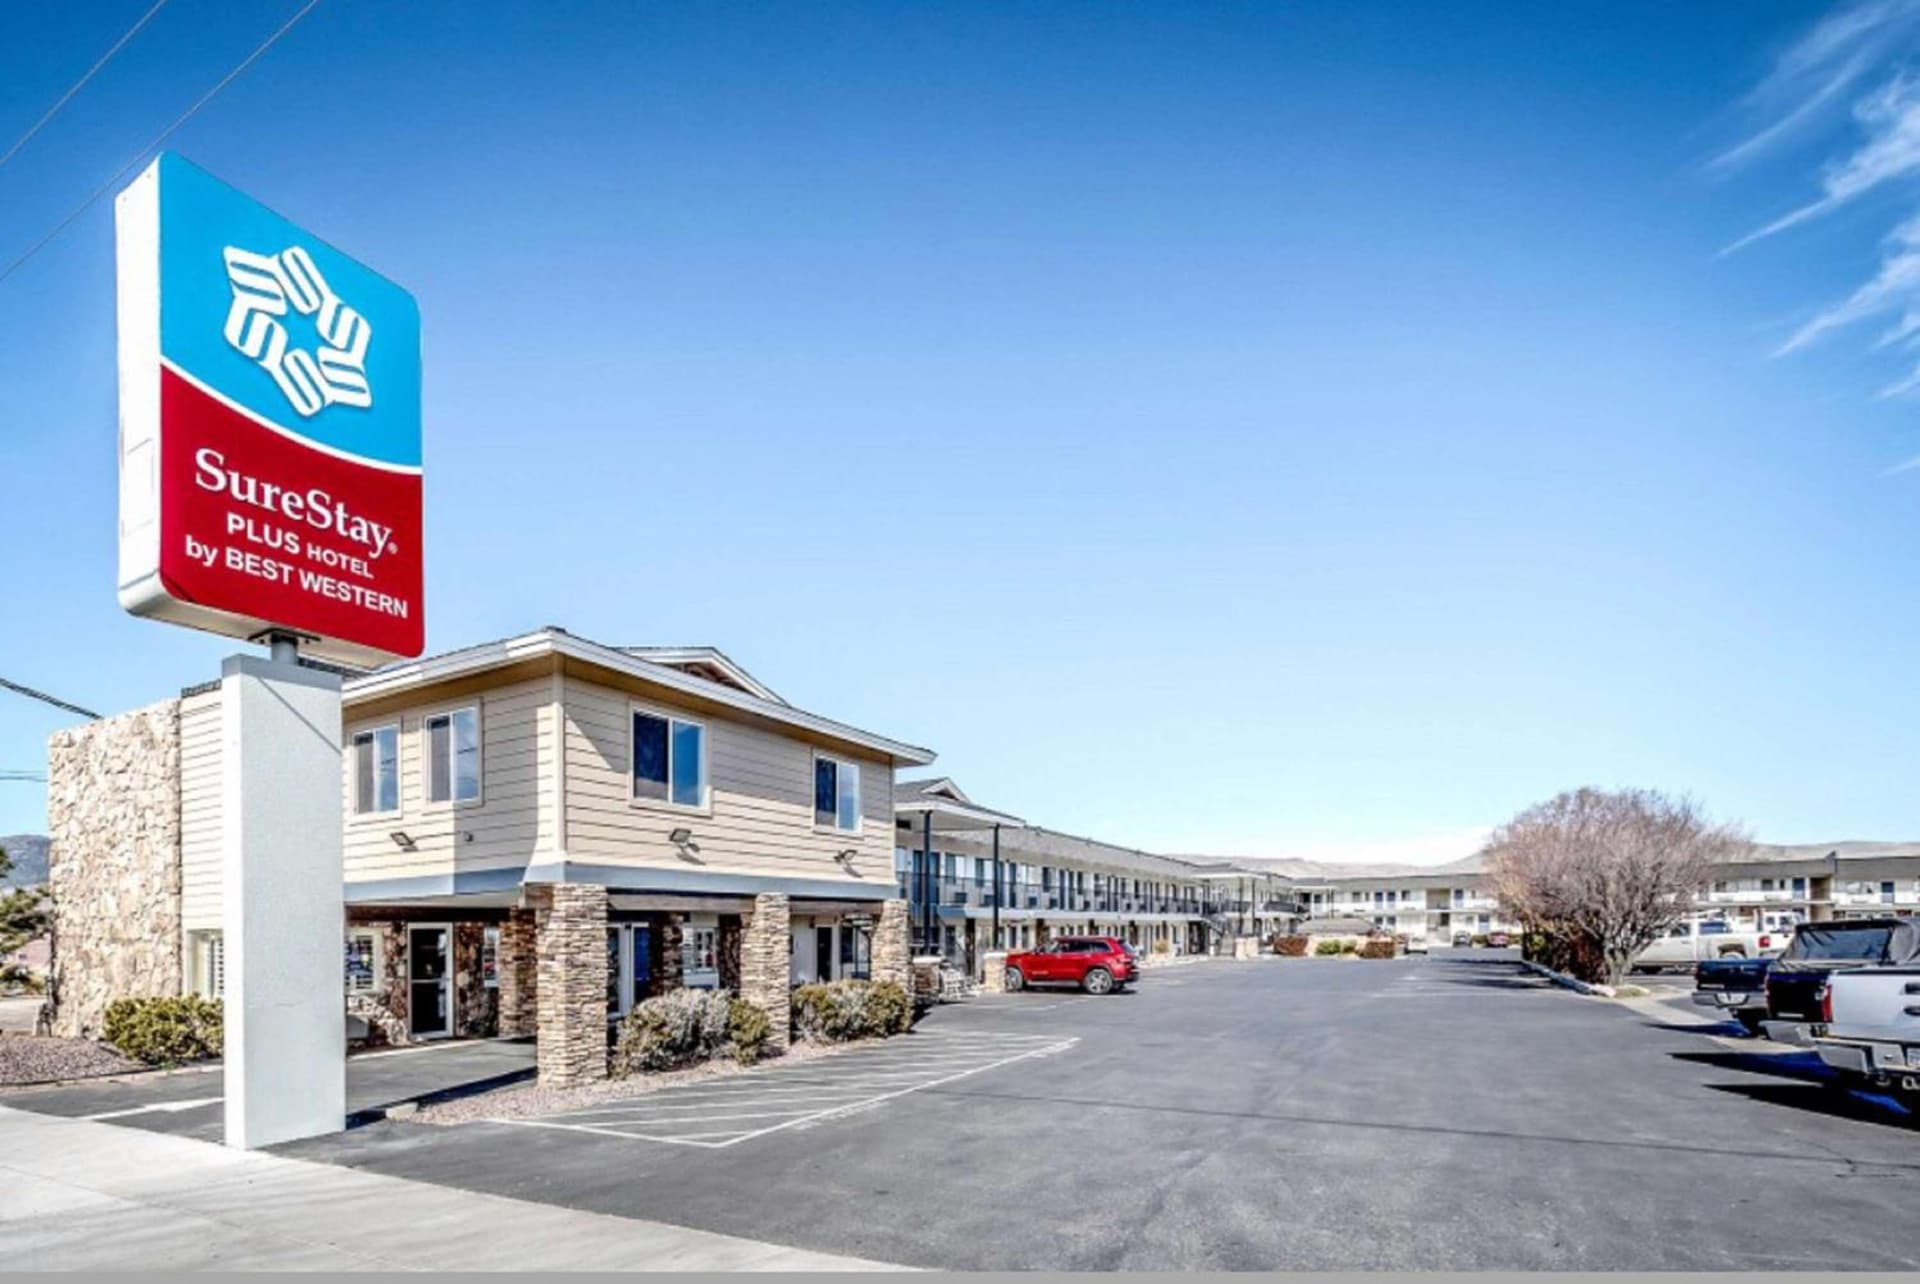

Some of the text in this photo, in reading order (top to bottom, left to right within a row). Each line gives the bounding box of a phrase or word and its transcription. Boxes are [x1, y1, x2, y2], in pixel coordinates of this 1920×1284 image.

[195, 448, 393, 559] SureStay
[226, 512, 375, 579] PLUS HOTEL
[185, 534, 409, 619] by BEST WESTERN
